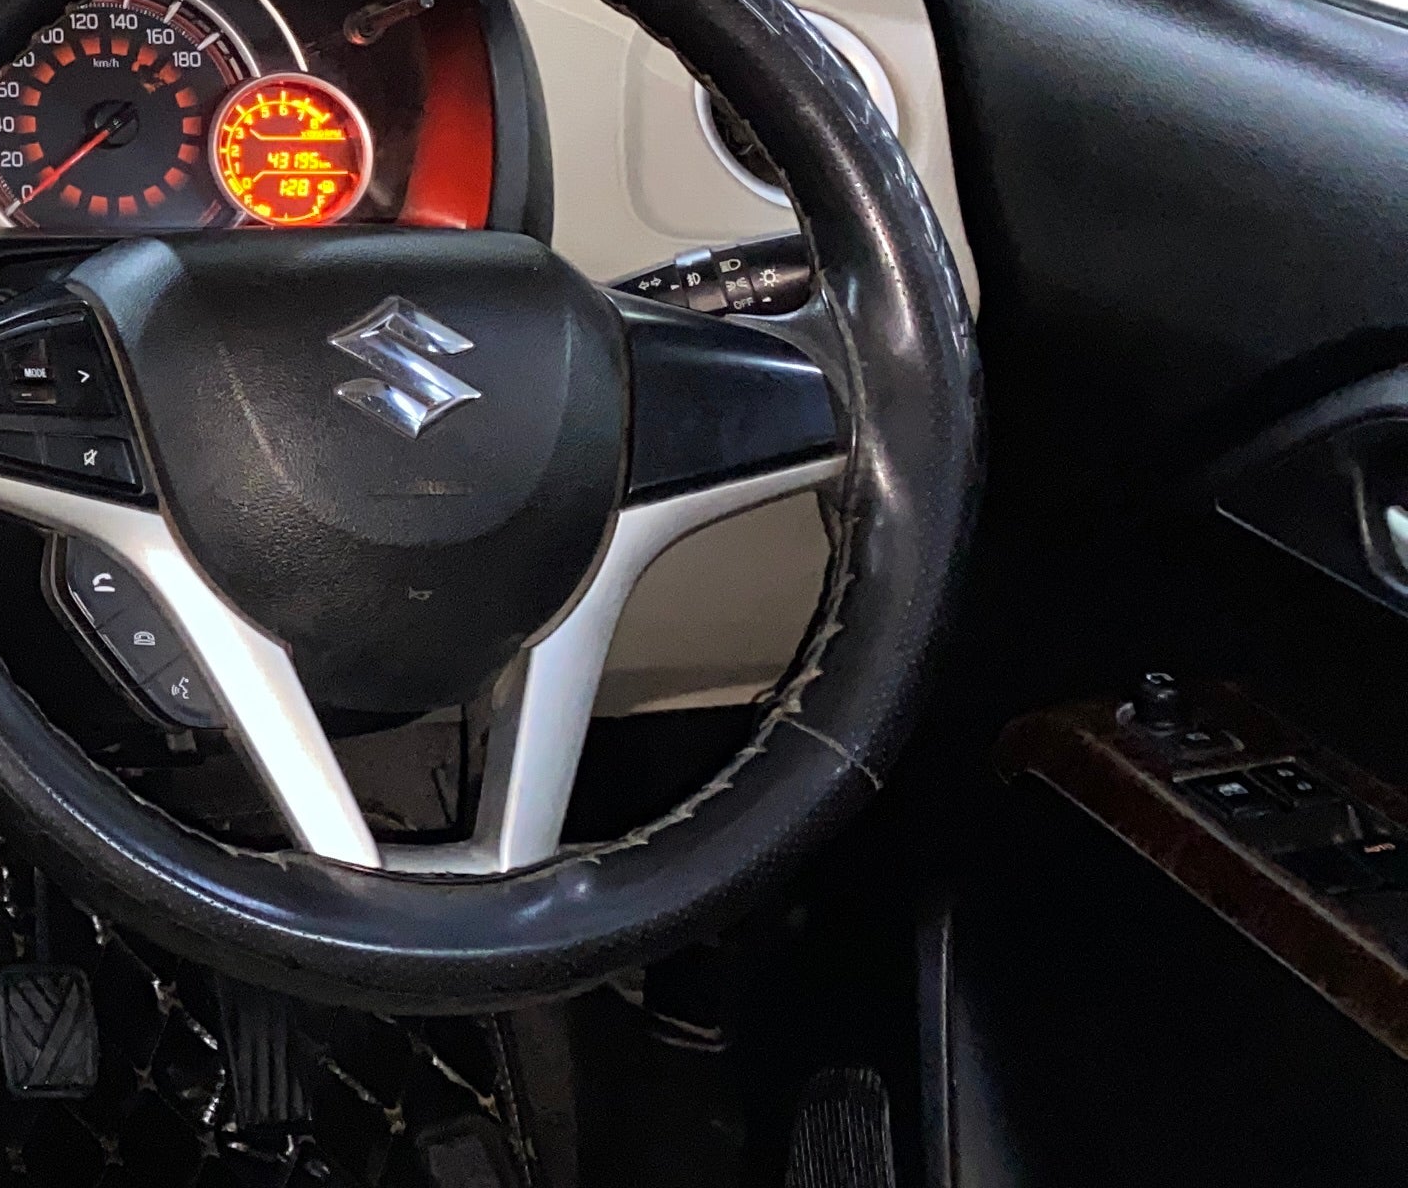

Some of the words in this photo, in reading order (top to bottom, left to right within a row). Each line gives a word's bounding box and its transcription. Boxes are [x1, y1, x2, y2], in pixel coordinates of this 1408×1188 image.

[70, 13, 98, 29] 120
[109, 14, 138, 30] 140
[146, 28, 175, 44] 160
[93, 58, 120, 68] km/h
[172, 51, 201, 67] 180
[279, 104, 288, 116] 6
[236, 127, 245, 139] 3
[231, 145, 240, 157] 2
[0, 151, 23, 167] 20
[267, 152, 319, 169] 43195
[234, 161, 240, 174] 1
[242, 177, 252, 190] 0
[21, 185, 32, 200] 0
[733, 296, 754, 310] OFF
[24, 367, 47, 378] MODE
